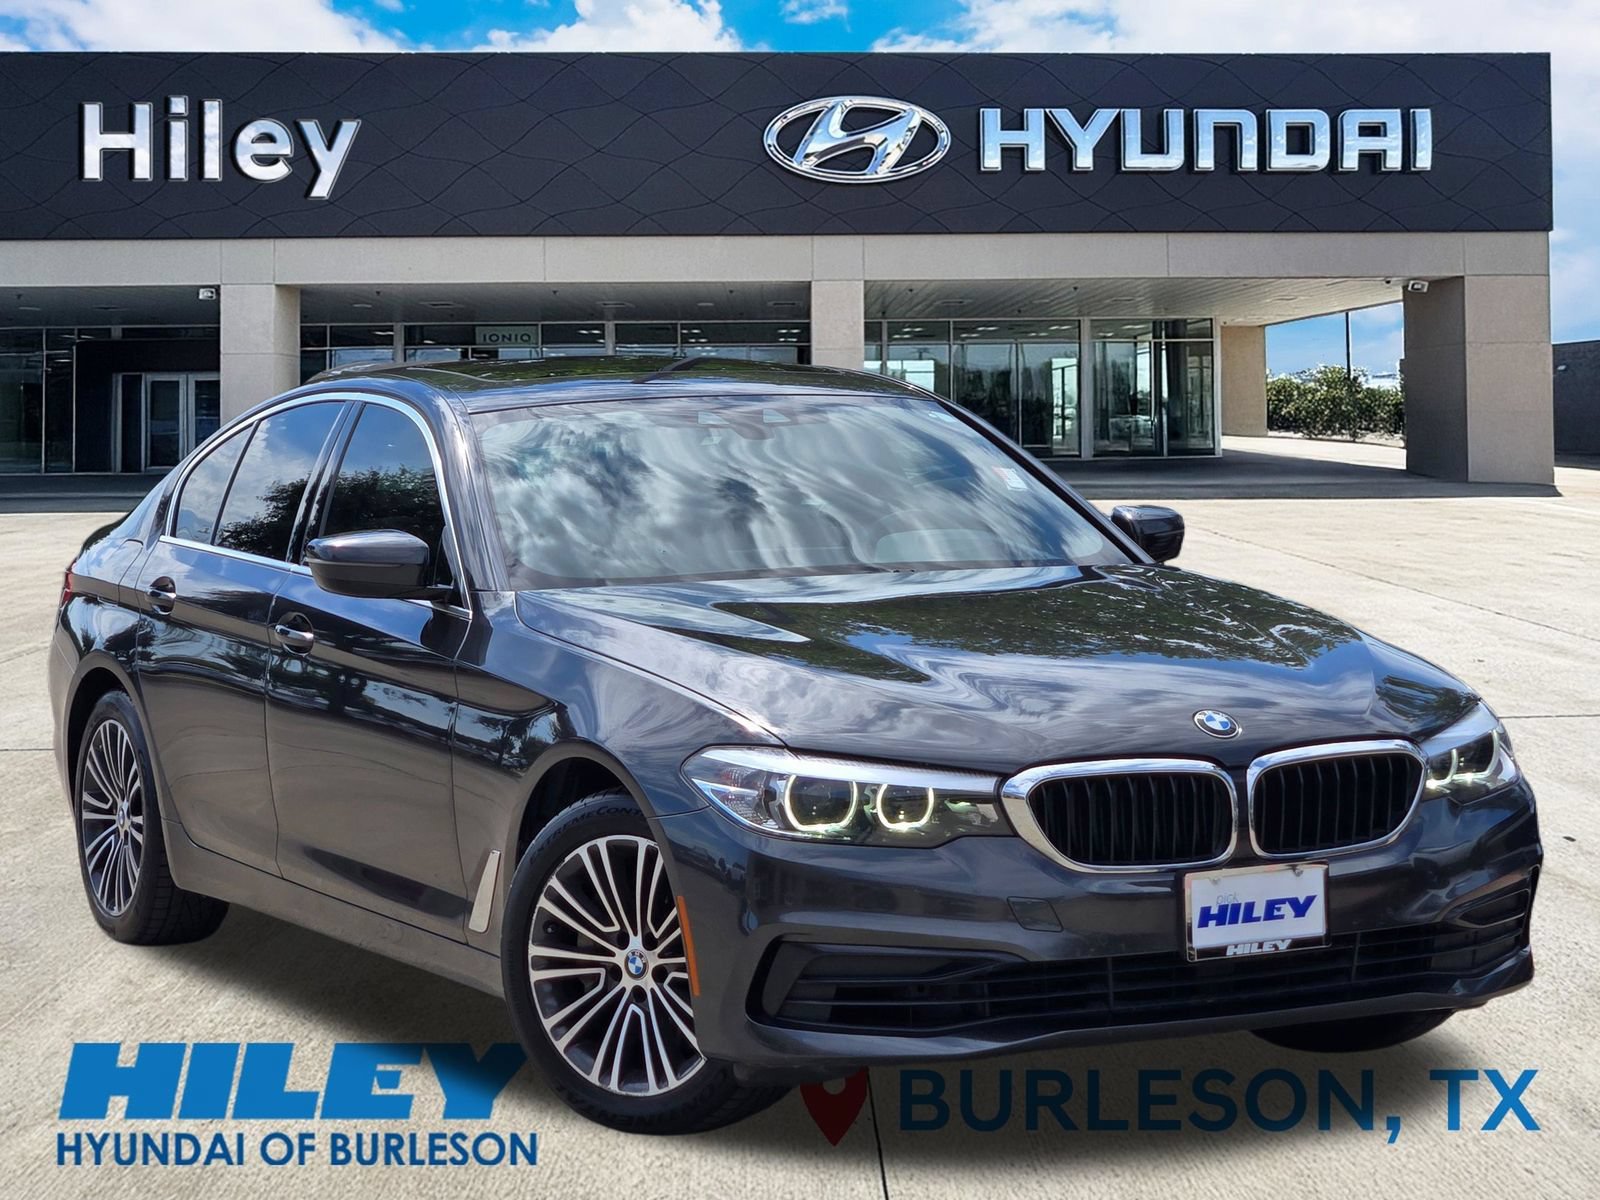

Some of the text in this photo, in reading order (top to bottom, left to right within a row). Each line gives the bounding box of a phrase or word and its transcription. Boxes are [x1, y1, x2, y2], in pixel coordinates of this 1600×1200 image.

[80, 95, 361, 199] Hiley
[979, 107, 1433, 172] HYUNDAI
[1197, 894, 1317, 928] HILEY
[1226, 939, 1292, 955] HILEY
